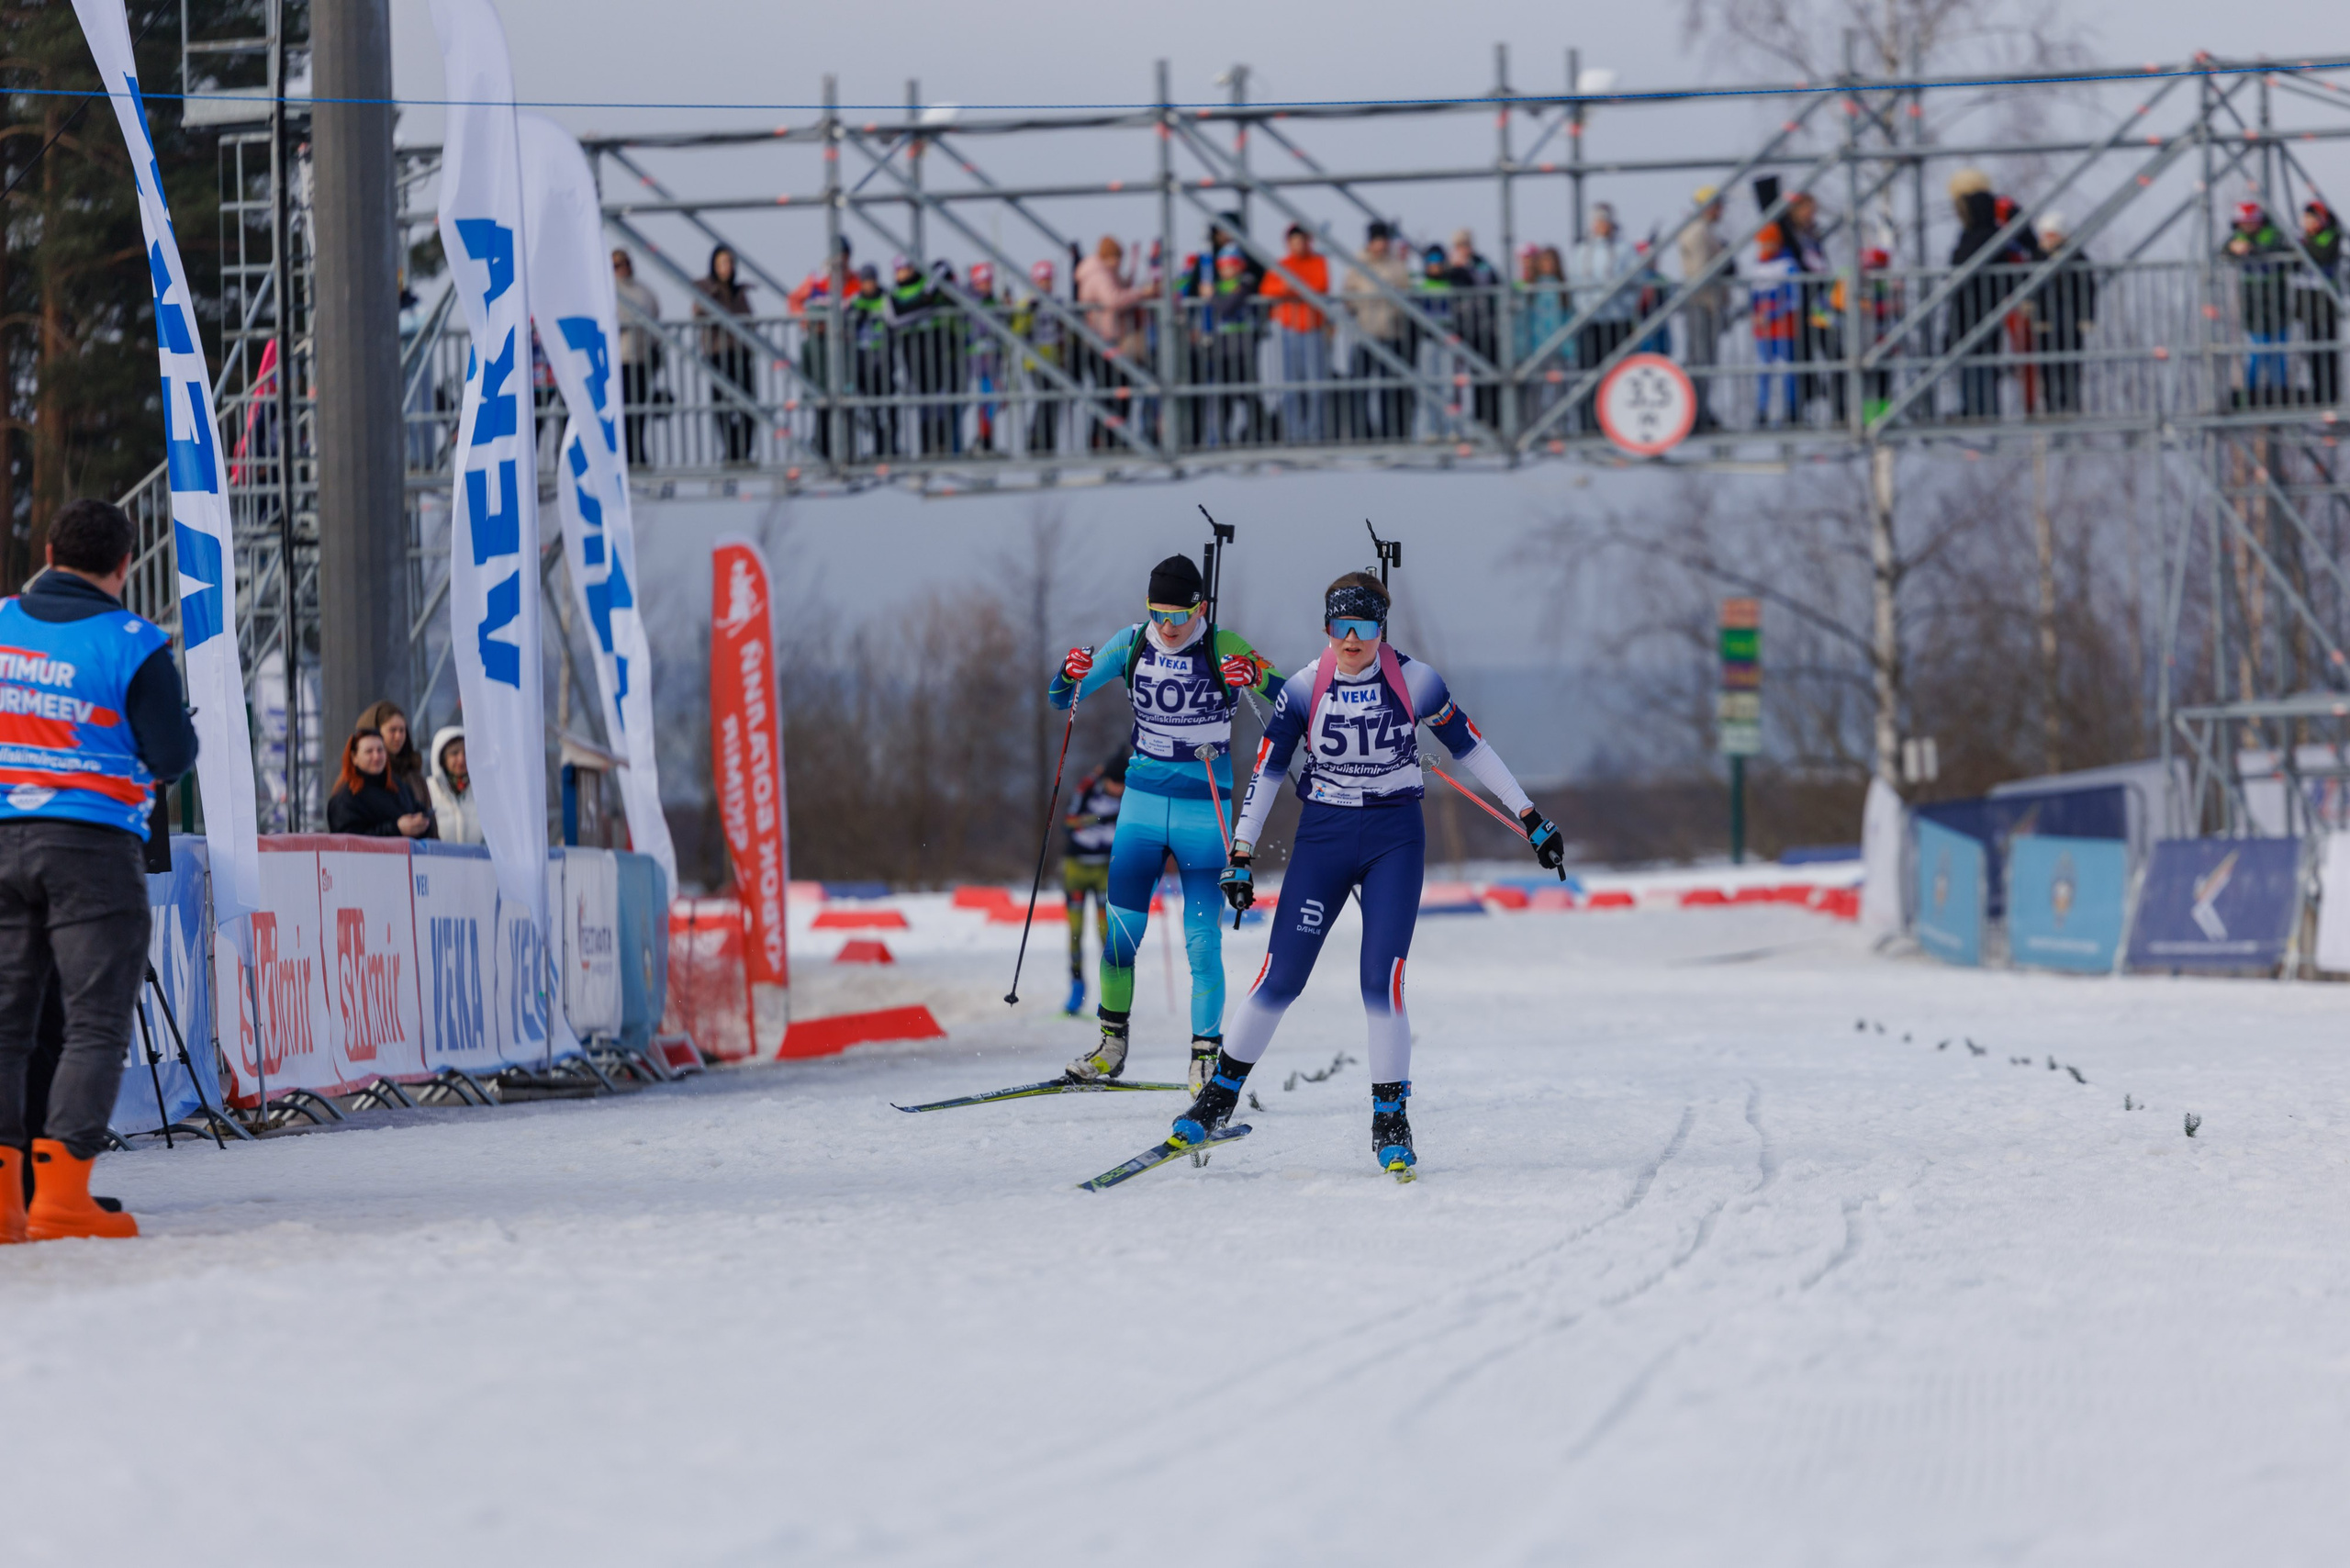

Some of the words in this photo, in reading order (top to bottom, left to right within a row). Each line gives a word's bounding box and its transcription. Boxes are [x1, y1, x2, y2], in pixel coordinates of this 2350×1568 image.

[1158, 656, 1188, 670] VEKA
[1135, 674, 1219, 713] 504
[1341, 689, 1377, 703] VEKA
[1319, 710, 1404, 757] 514
[431, 916, 485, 1052] VEKA
